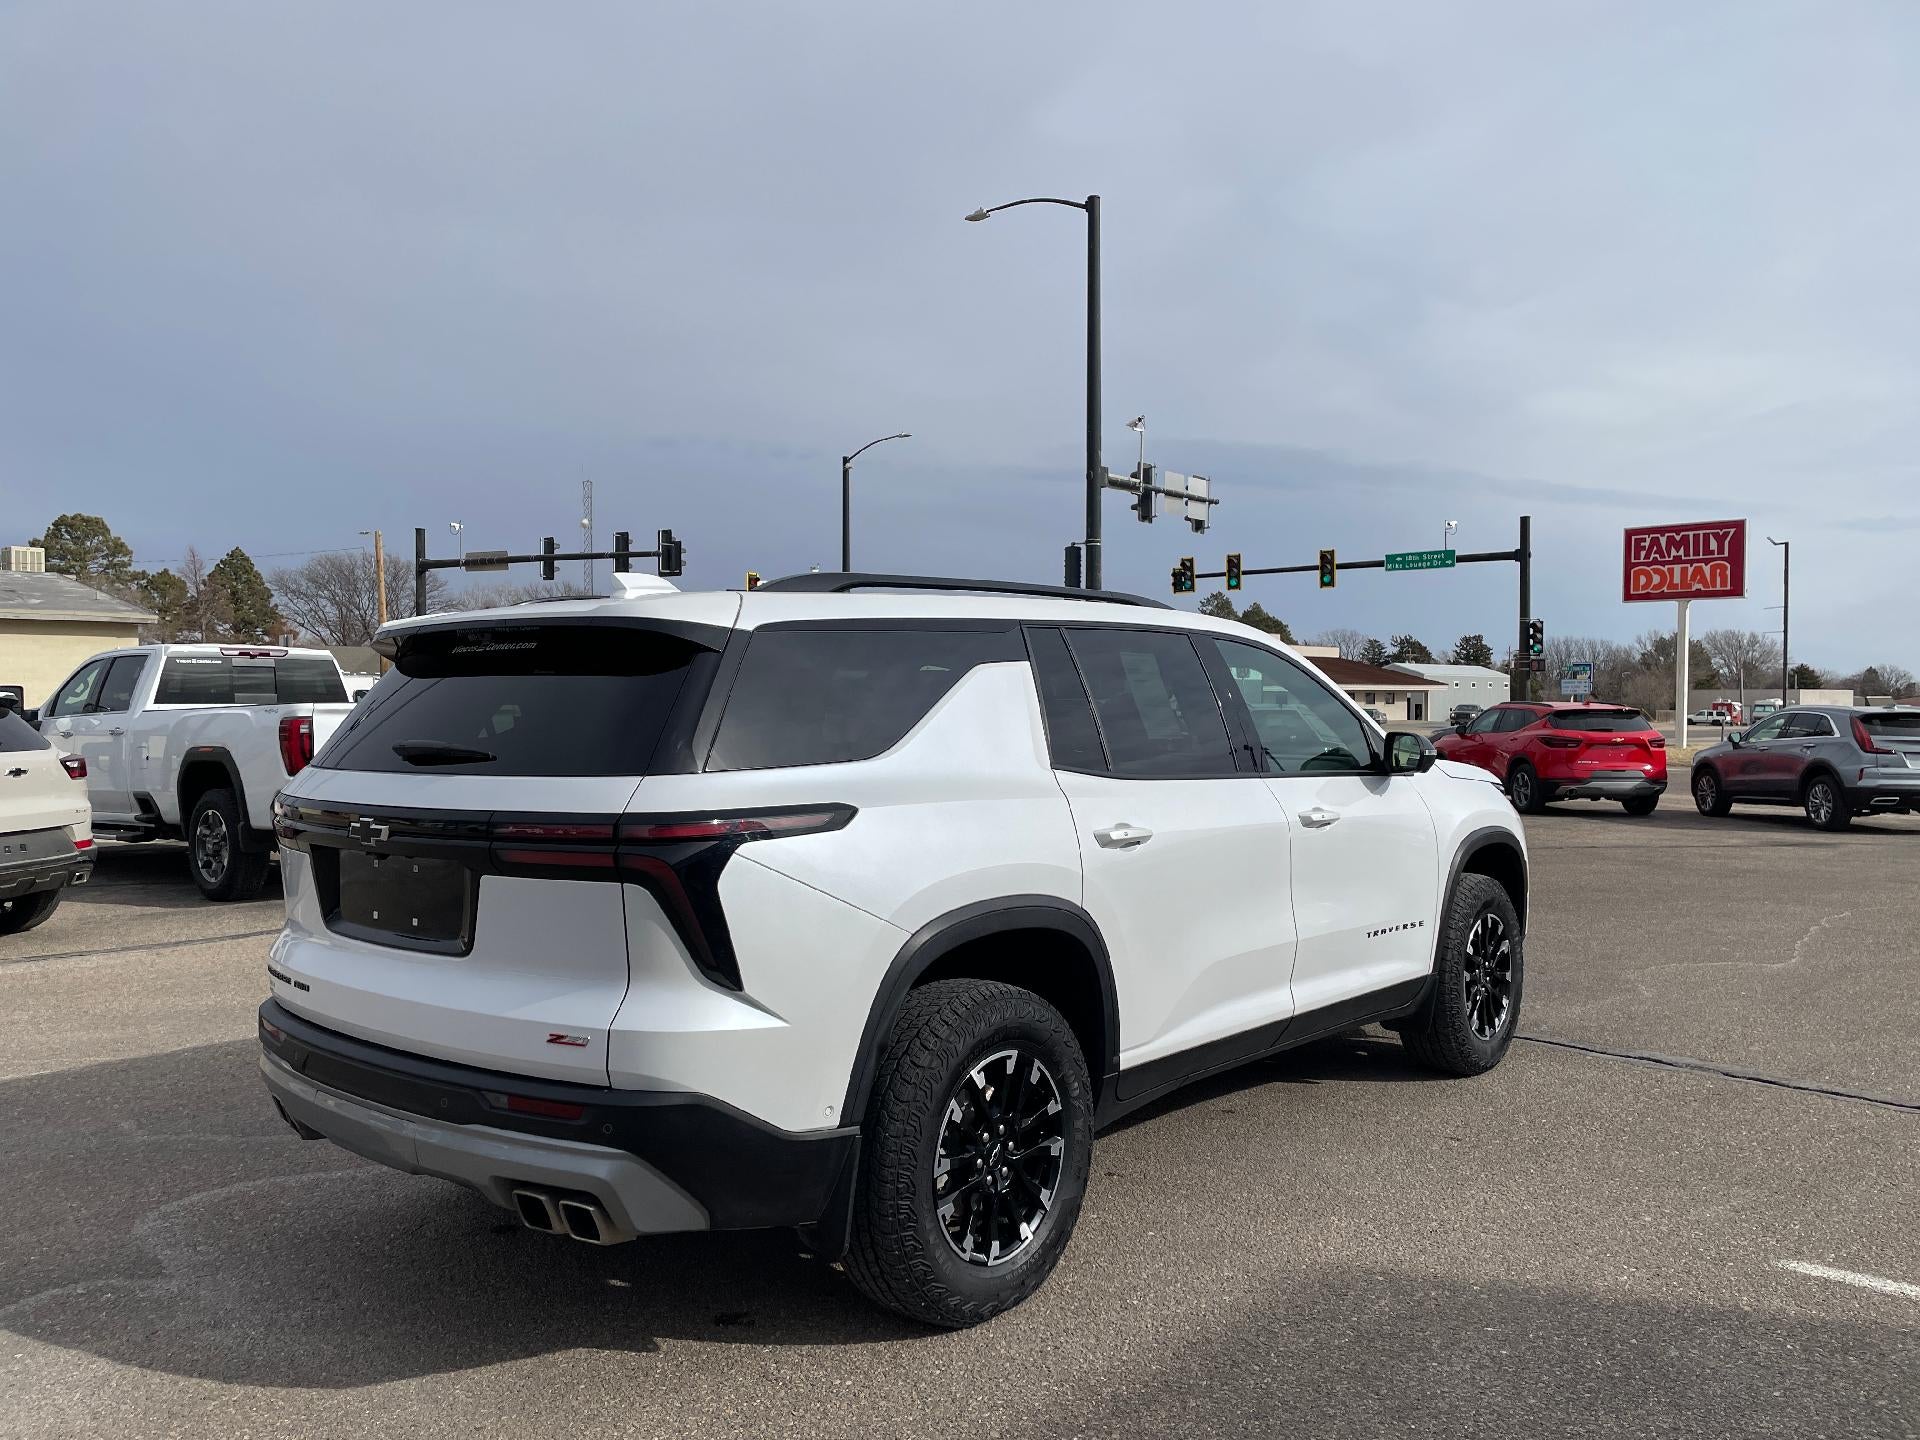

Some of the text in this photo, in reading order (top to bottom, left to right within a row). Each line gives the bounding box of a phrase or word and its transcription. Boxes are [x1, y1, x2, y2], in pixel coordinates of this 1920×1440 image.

[1631, 528, 1736, 562] FAMILY
[1387, 562, 1403, 570] Mike
[1432, 559, 1442, 567] Dr
[1422, 552, 1445, 560] Street
[1630, 561, 1731, 594] DOLLAR
[1366, 920, 1425, 939] TRAVERSE
